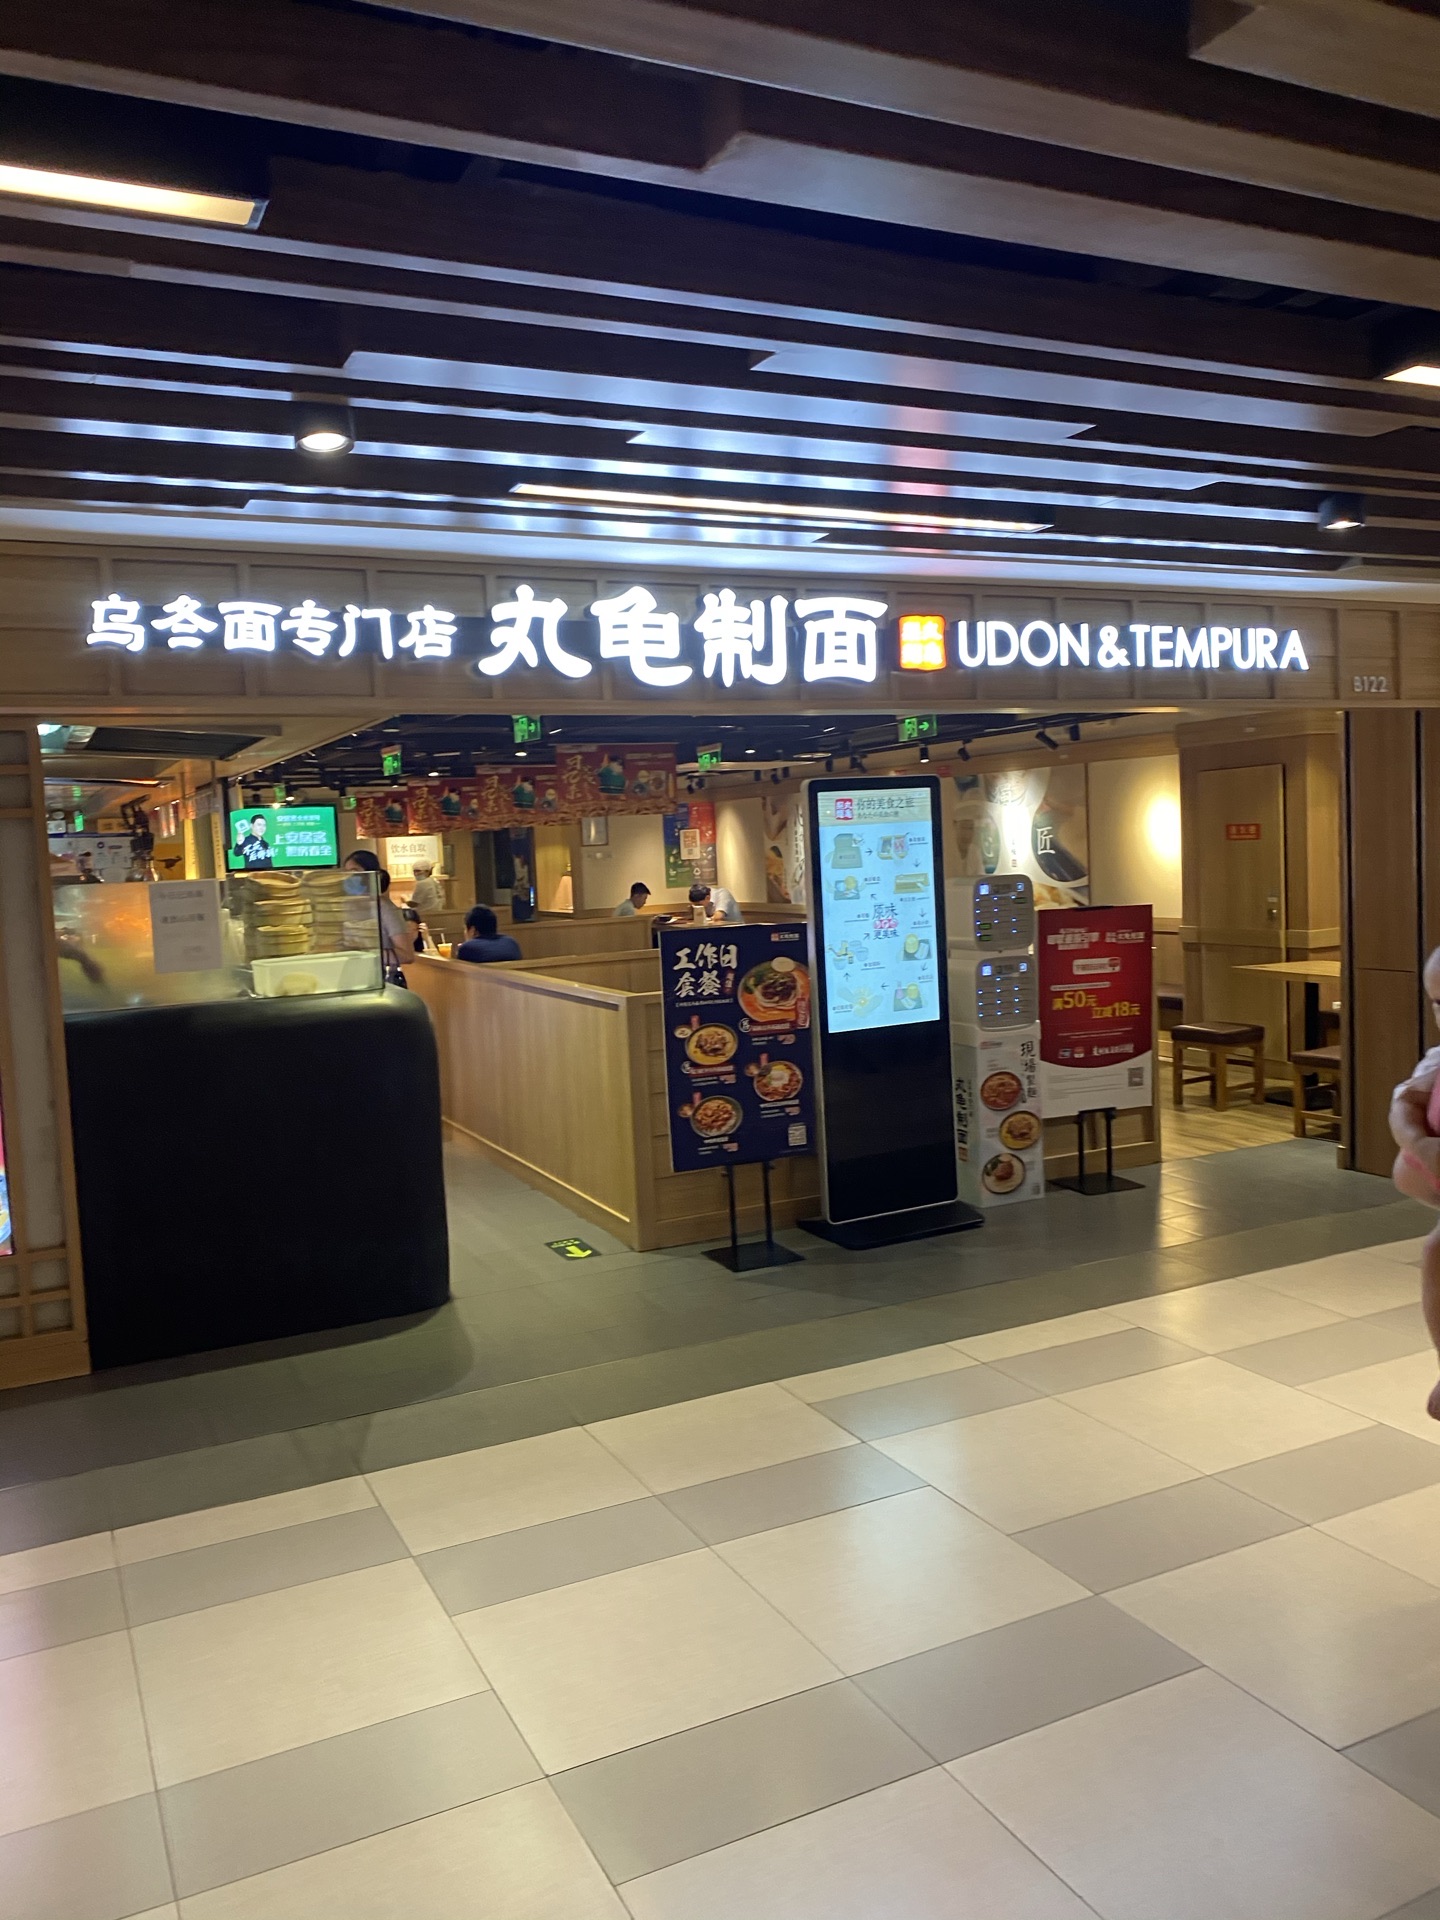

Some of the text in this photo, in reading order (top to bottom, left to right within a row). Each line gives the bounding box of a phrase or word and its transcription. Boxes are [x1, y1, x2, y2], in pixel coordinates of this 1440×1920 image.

[86, 593, 458, 660] 乌冬面专门店
[1354, 676, 1389, 692] B122
[391, 843, 427, 853] 饮水自取
[1036, 826, 1056, 855] 匠
[673, 942, 738, 971] 工作日
[674, 970, 721, 998] 套餐
